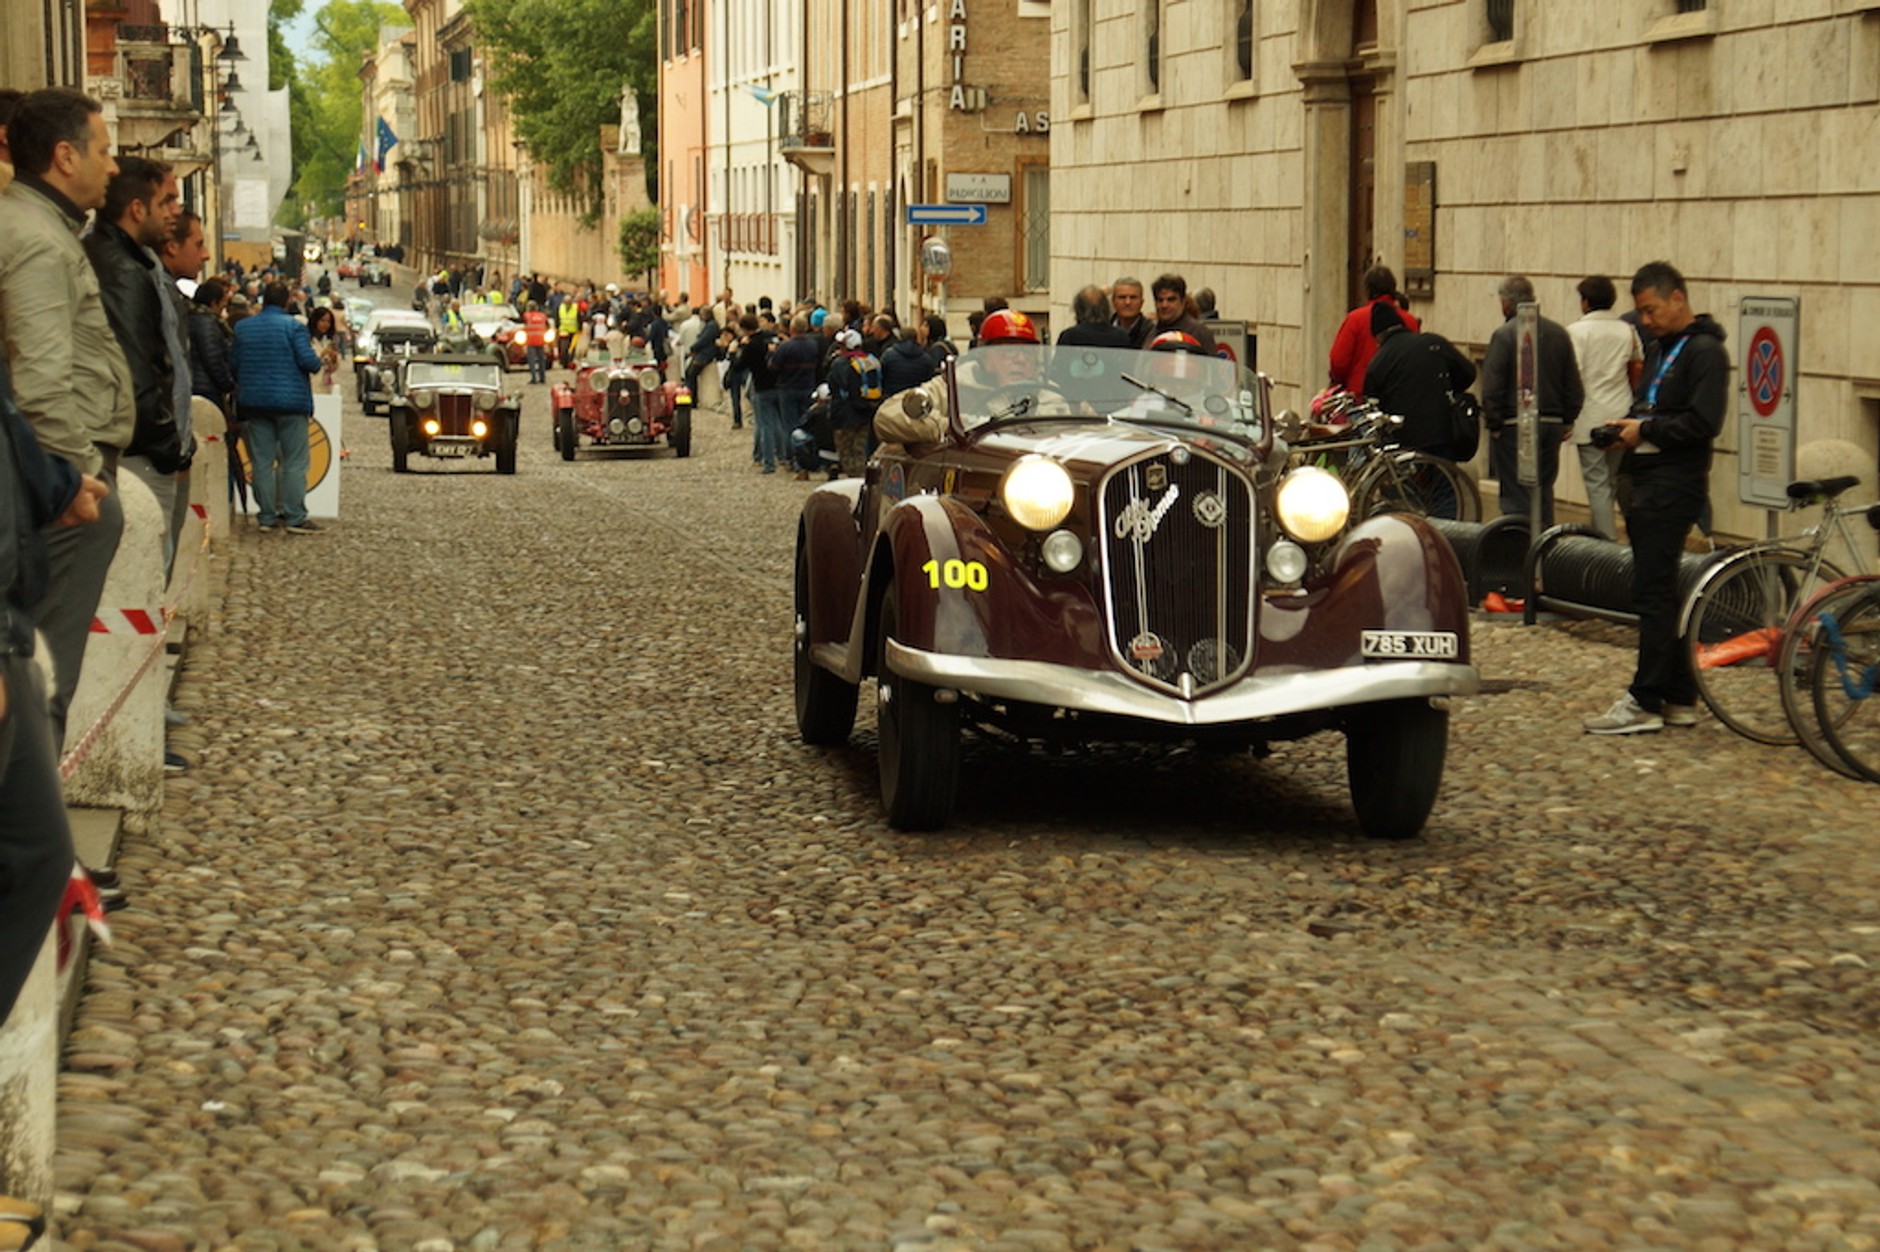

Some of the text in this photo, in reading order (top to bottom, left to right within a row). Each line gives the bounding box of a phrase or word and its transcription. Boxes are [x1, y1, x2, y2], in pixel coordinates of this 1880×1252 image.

[922, 558, 988, 592] 100
[1365, 634, 1452, 655] 785 XUH
